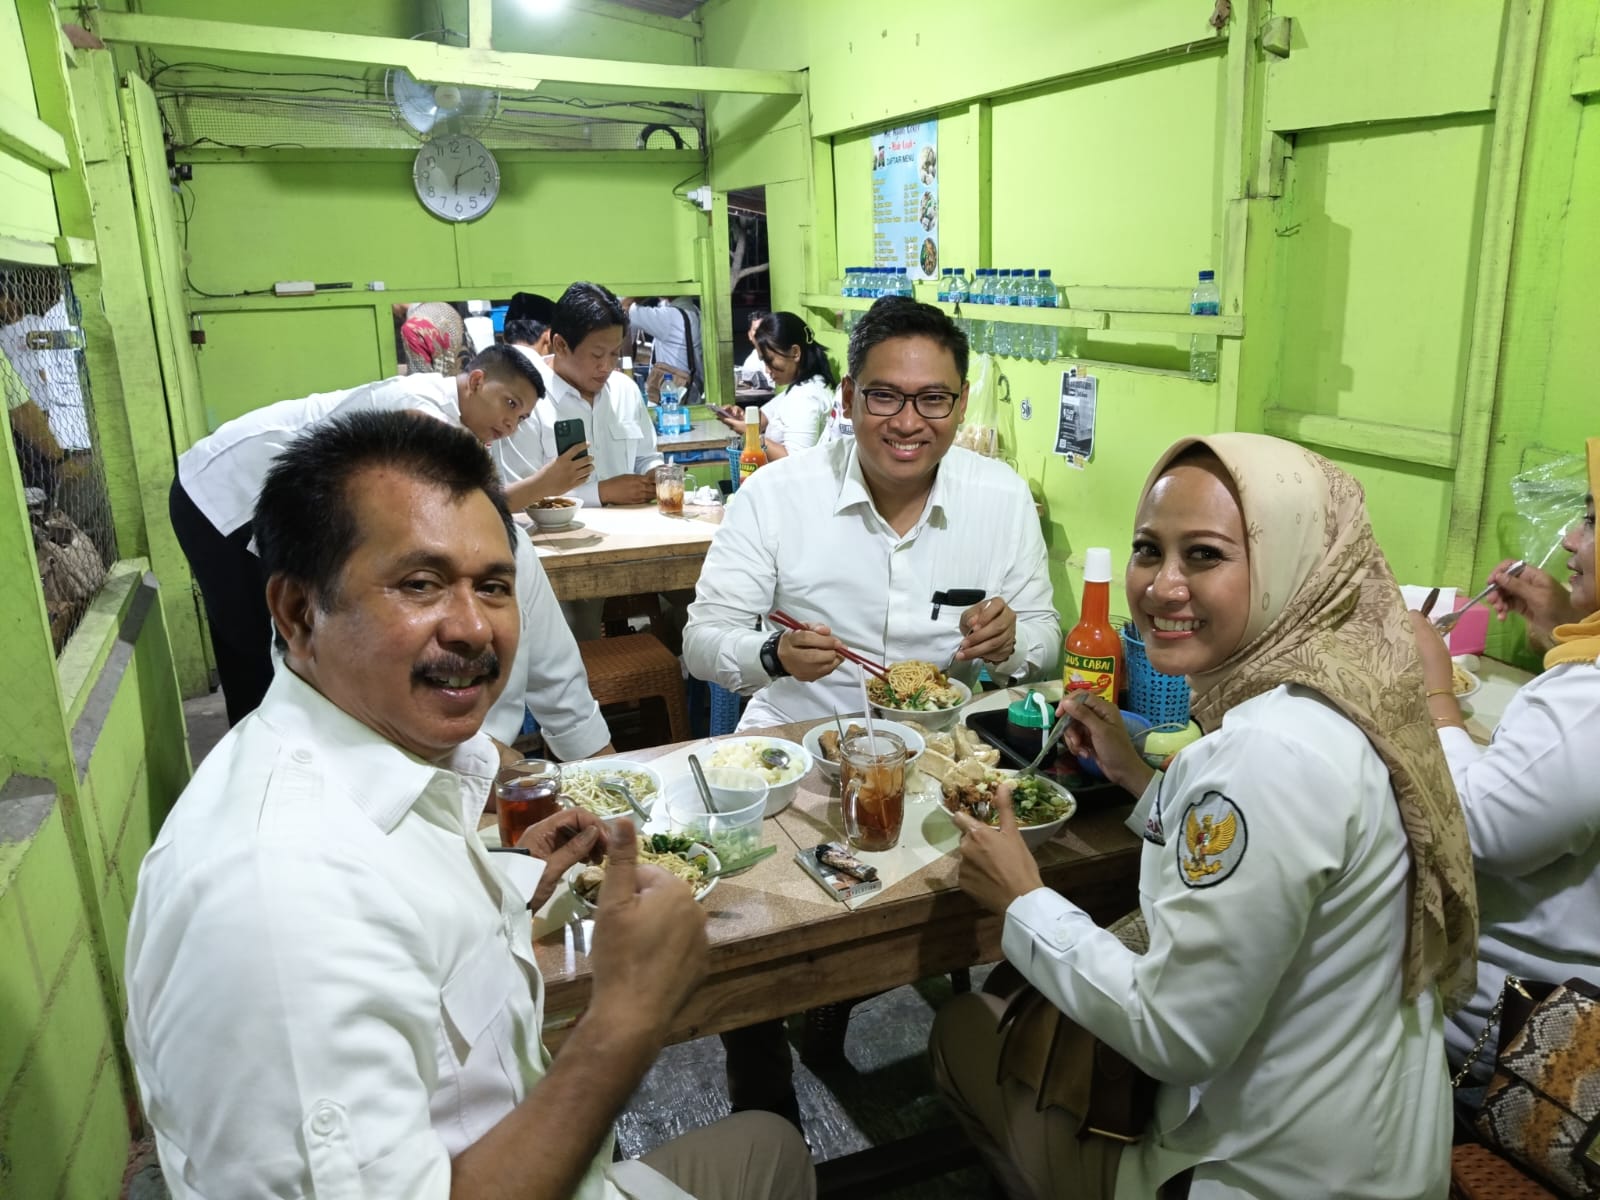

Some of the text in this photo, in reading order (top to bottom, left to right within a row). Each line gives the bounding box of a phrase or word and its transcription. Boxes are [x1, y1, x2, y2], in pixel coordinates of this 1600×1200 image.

[437, 145, 444, 157] 11
[448, 140, 460, 153] 12
[466, 144, 472, 157] 1
[478, 155, 486, 168] 2
[422, 170, 430, 182] 9
[484, 170, 491, 183] 3
[428, 186, 436, 198] 8
[479, 186, 487, 198] 4
[440, 196, 447, 209] 7
[455, 201, 463, 213] 6
[469, 196, 478, 209] 5
[1083, 658, 1111, 671] CABAI
